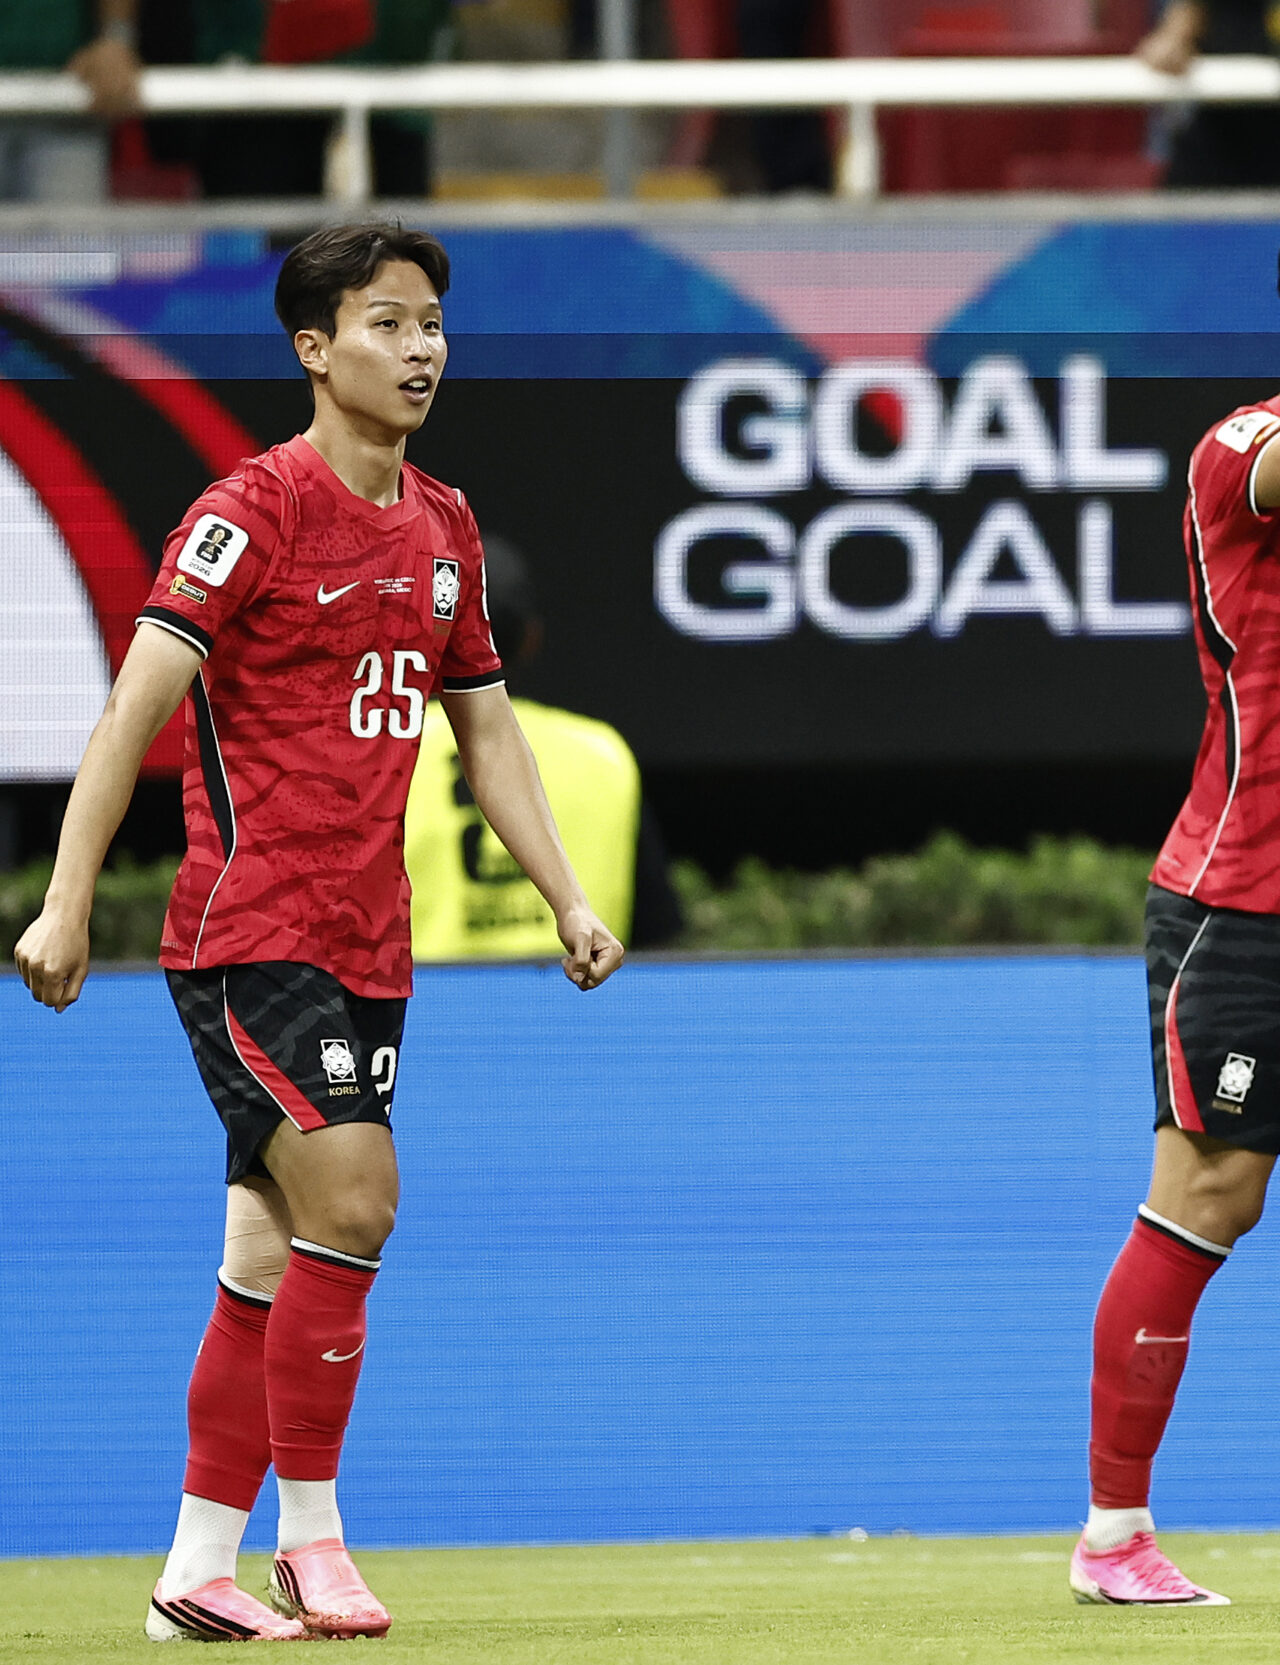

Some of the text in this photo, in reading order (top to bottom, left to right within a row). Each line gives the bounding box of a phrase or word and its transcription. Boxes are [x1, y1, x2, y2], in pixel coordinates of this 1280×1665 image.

[676, 357, 1168, 494] GOAL
[188, 561, 211, 577] 2026
[654, 501, 1191, 640] GOAL
[350, 650, 429, 739] 25
[328, 1086, 361, 1097] KOREA
